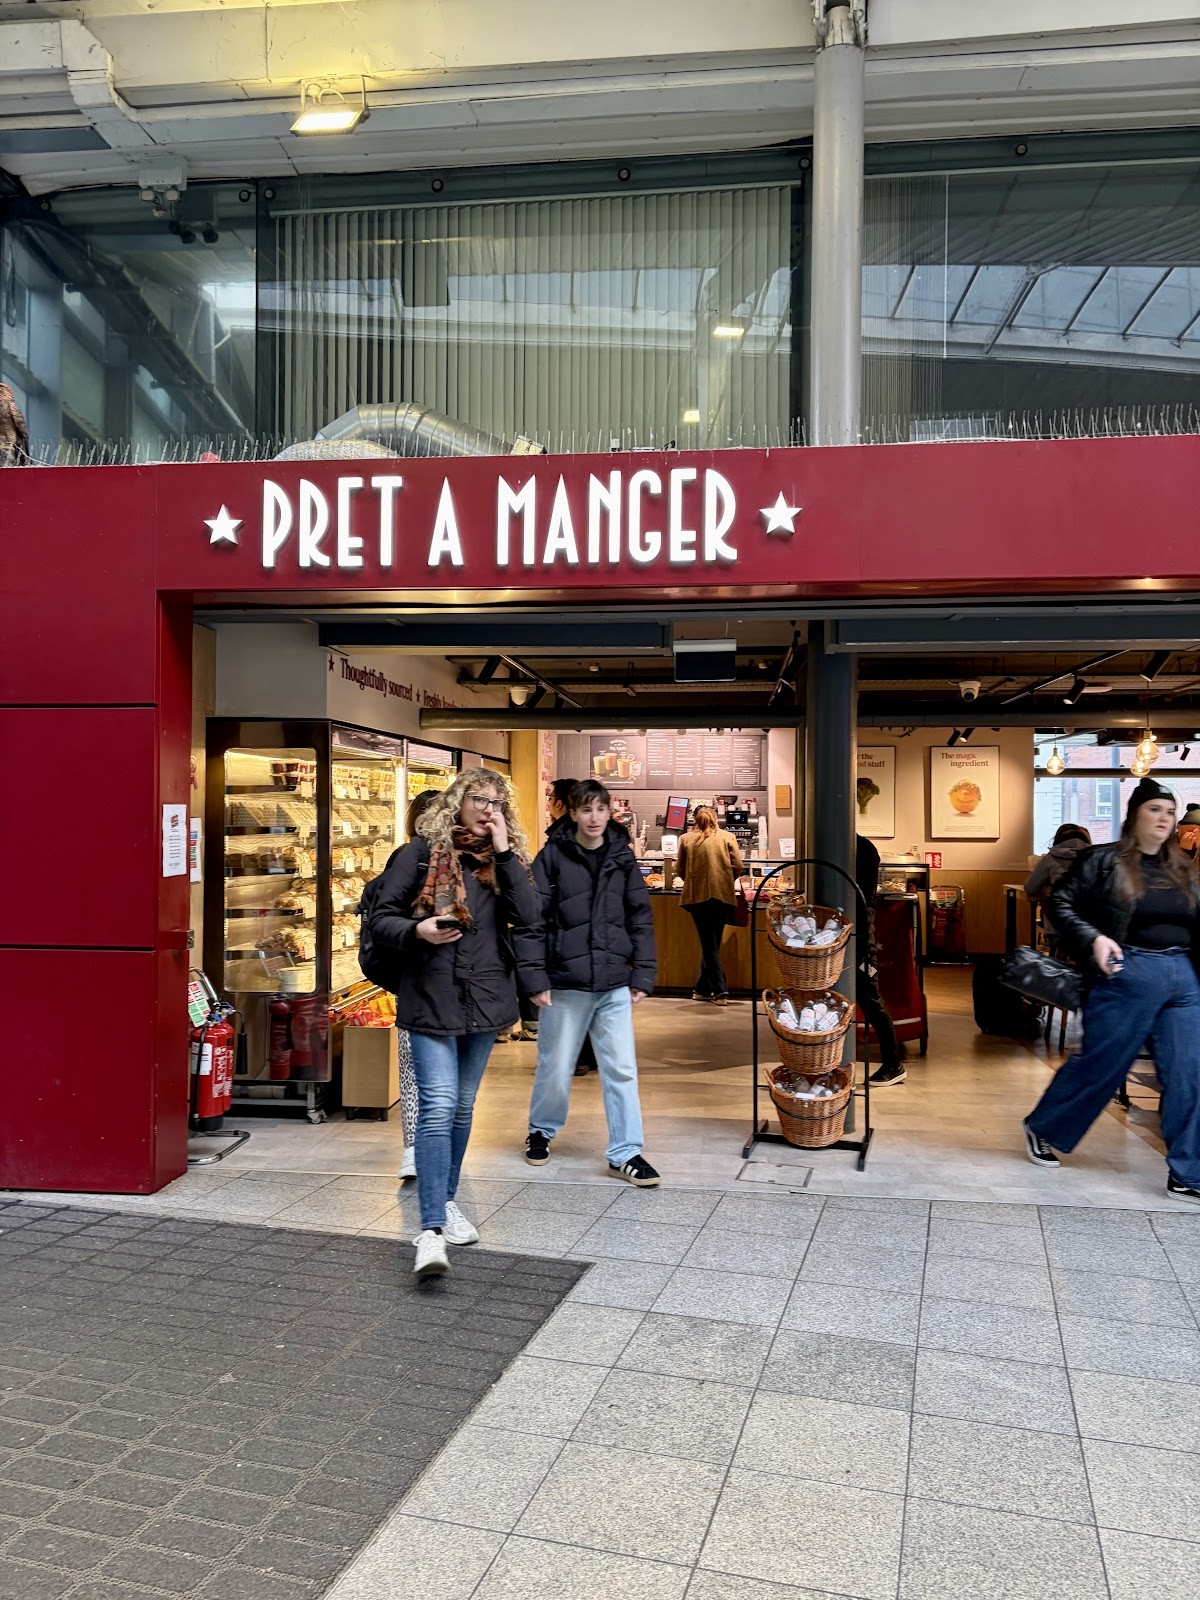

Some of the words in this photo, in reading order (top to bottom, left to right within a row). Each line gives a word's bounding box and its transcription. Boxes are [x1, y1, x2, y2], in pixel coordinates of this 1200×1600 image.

[263, 475, 402, 568] PRET
[428, 477, 465, 567] A
[496, 468, 738, 566] MANGER
[340, 658, 387, 698] Thoughtfully
[389, 683, 413, 702] sourced
[940, 752, 954, 760] The
[955, 753, 977, 761] magic
[950, 760, 989, 768] ingredient
